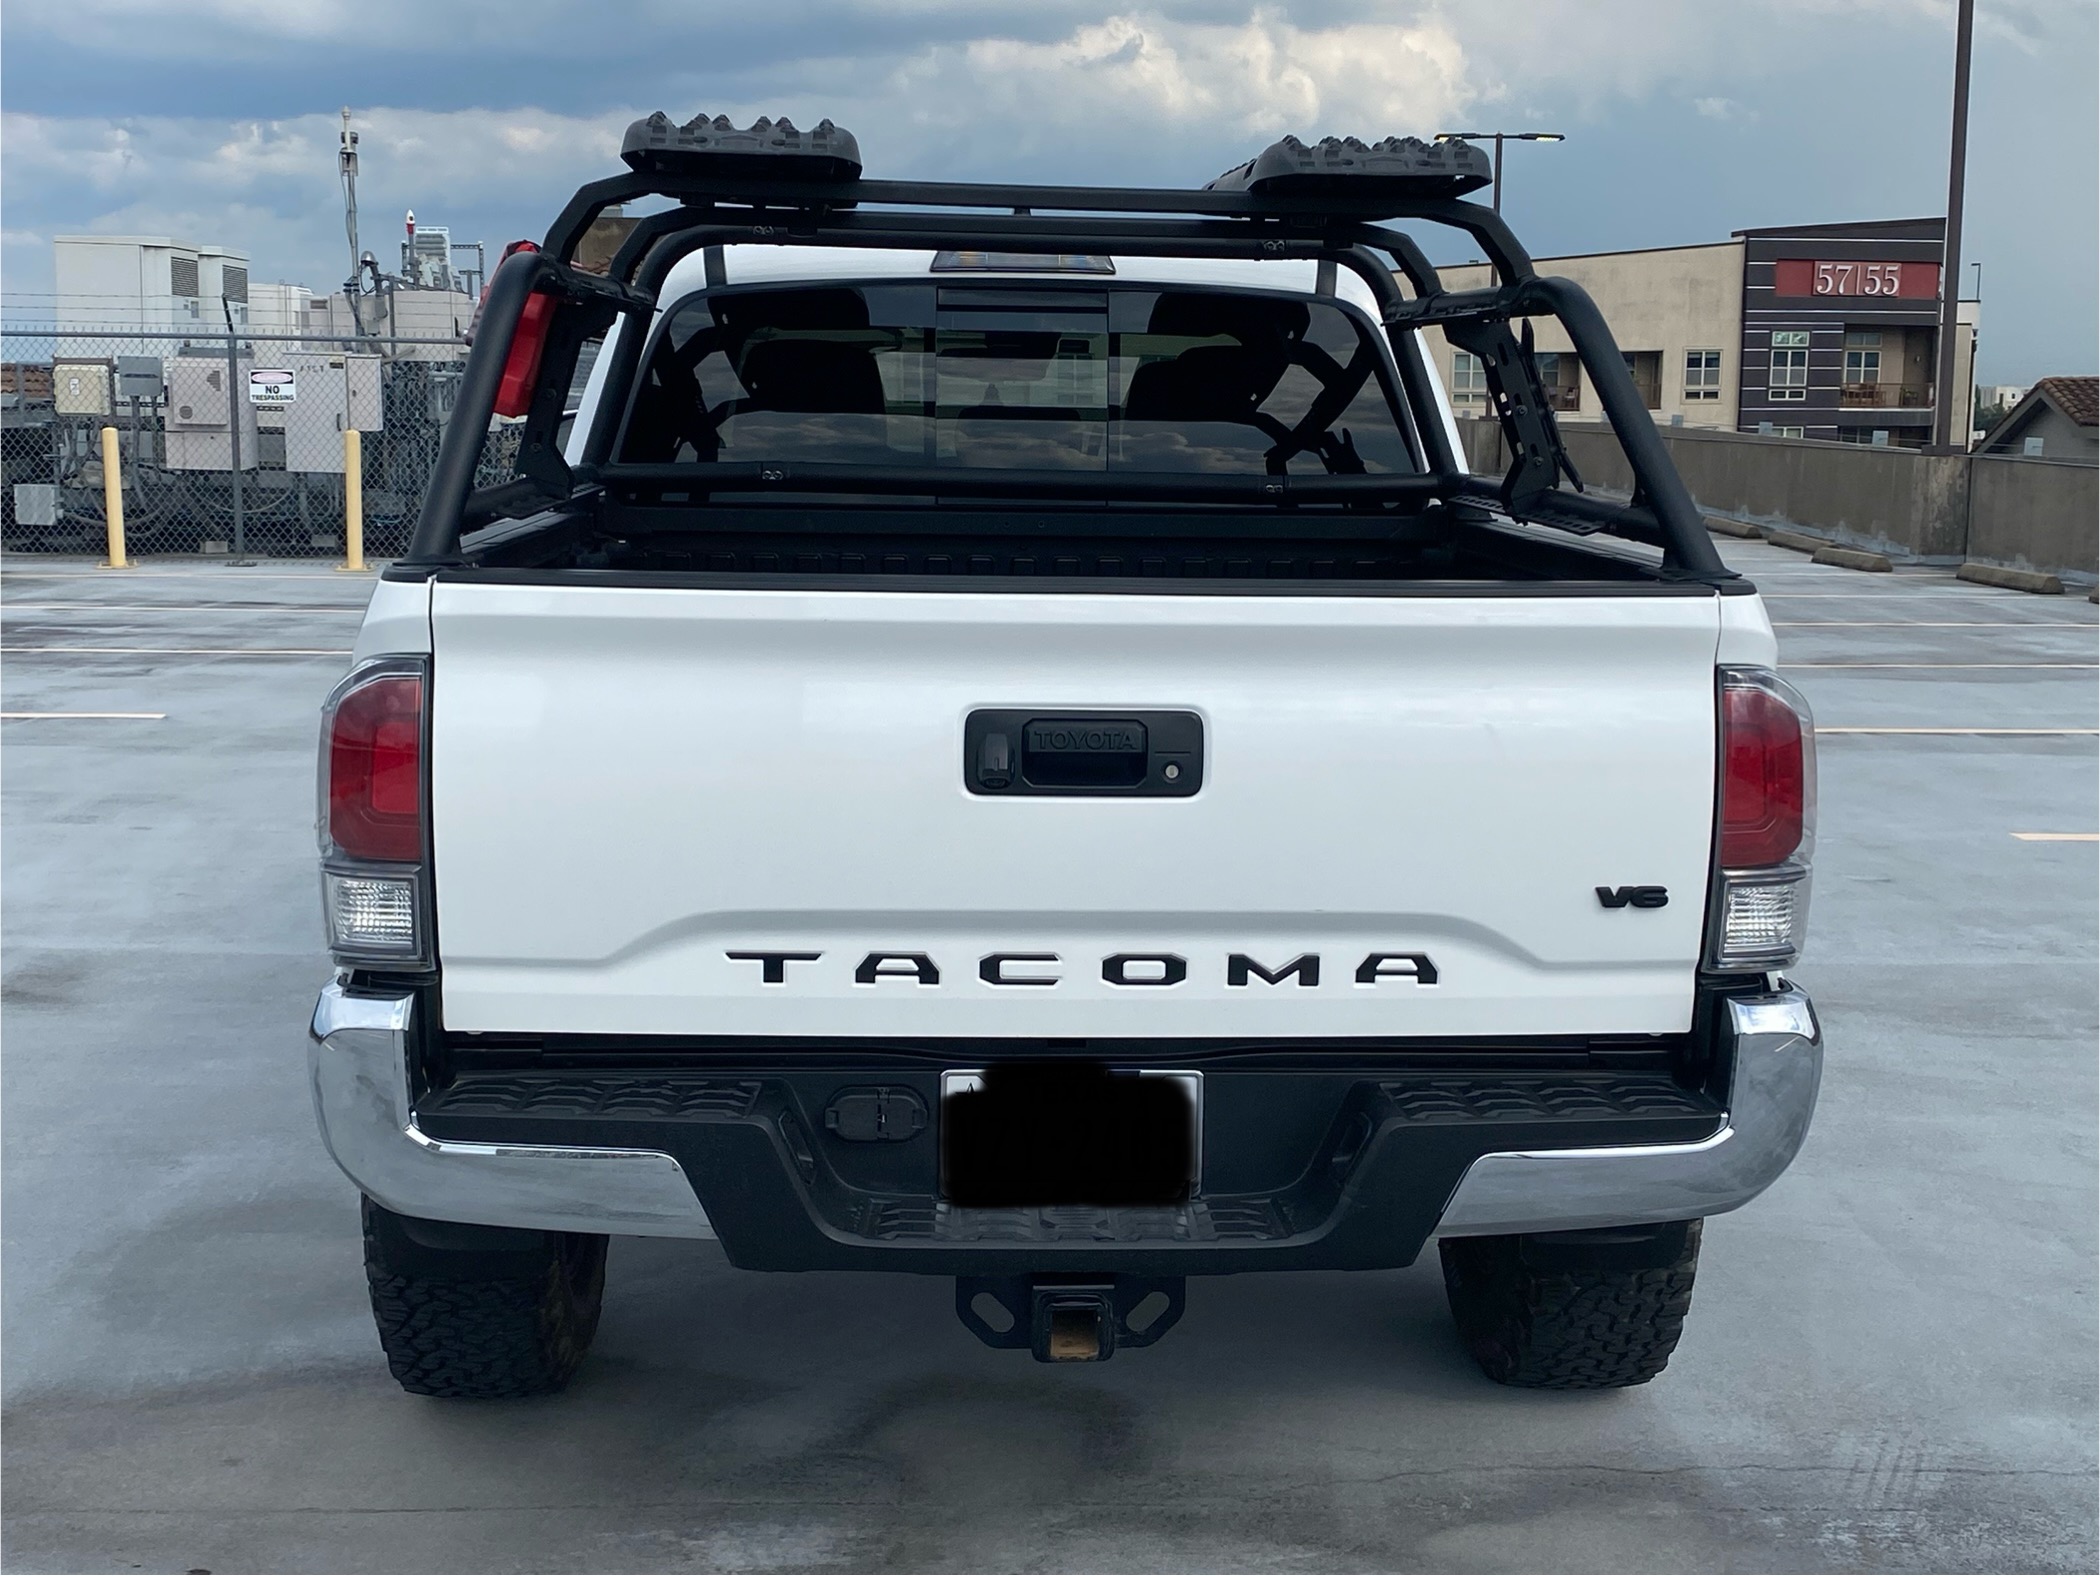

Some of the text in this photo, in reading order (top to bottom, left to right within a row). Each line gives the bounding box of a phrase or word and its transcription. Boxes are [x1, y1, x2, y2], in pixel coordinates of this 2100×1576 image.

[265, 385, 280, 395] NO
[1034, 730, 1137, 751] TOYOTA
[1595, 885, 1669, 909] V6
[724, 951, 1440, 987] TACOMA
